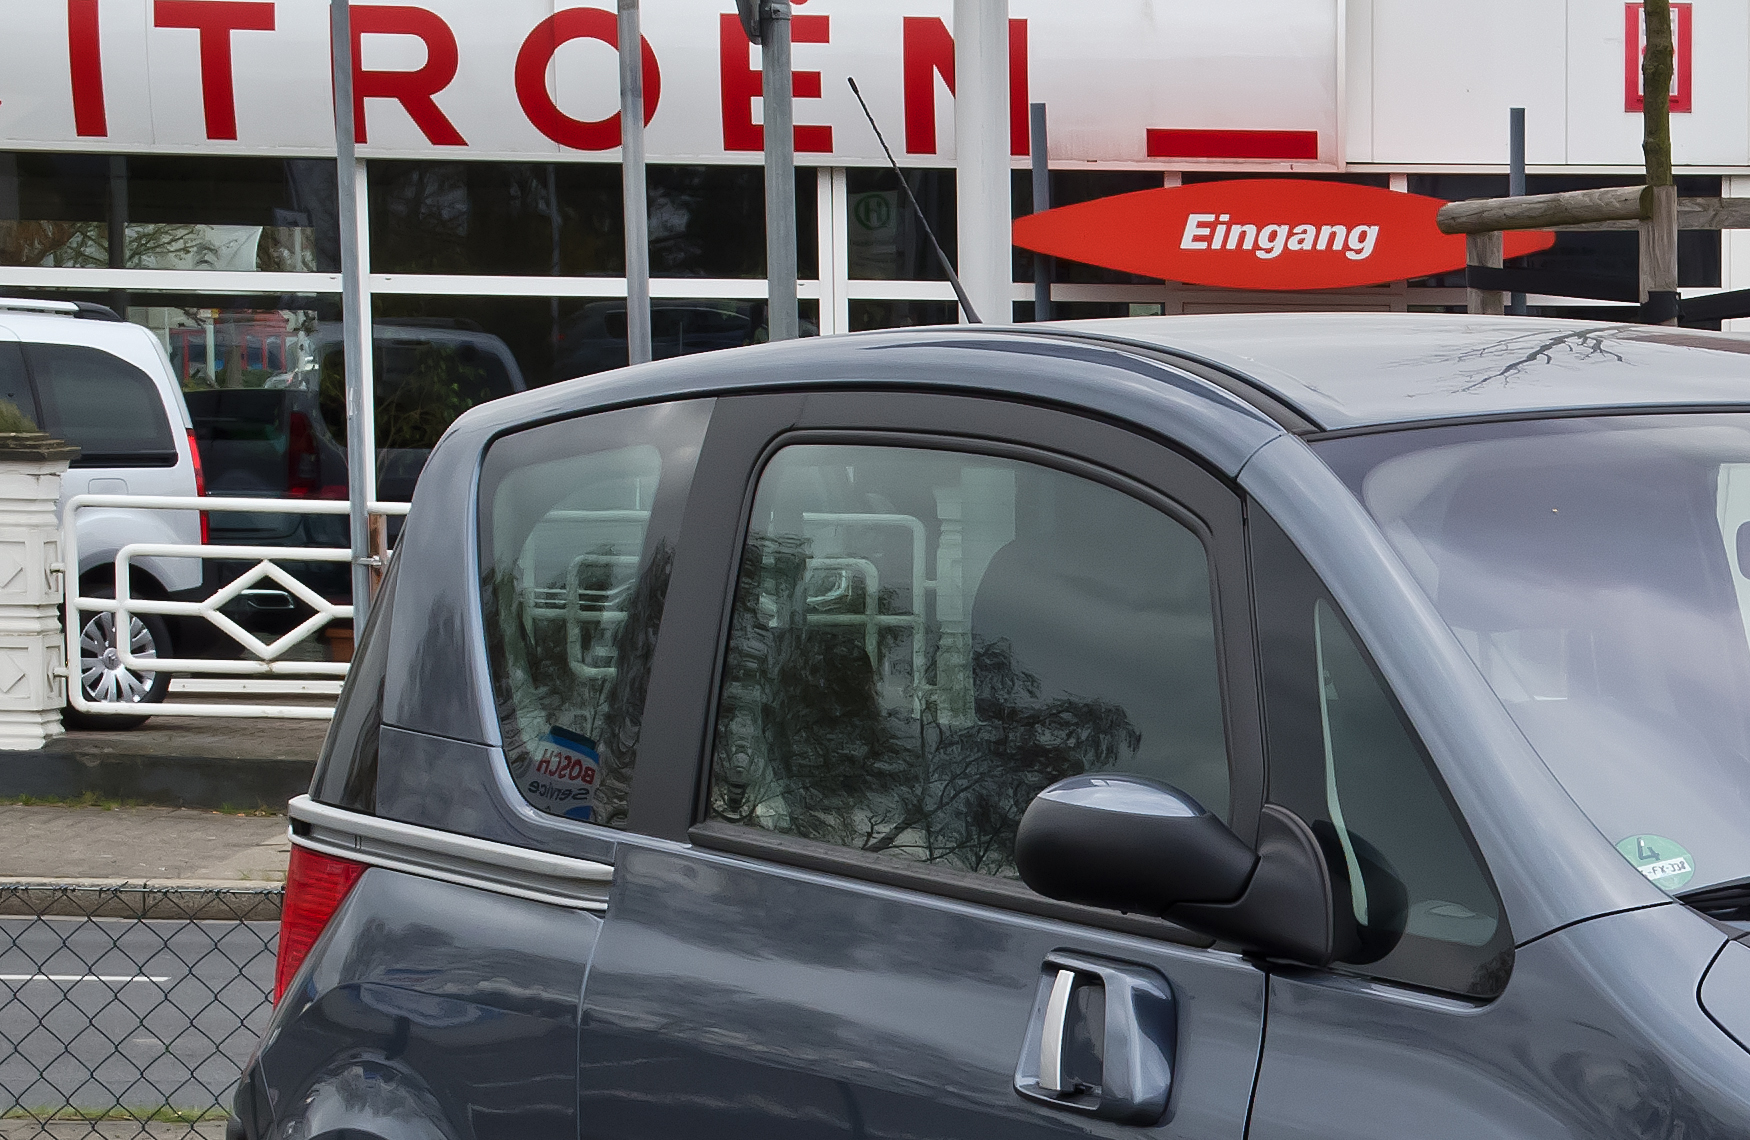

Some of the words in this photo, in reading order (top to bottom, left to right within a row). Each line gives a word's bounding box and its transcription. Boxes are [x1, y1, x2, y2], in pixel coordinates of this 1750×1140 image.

[60, 0, 1030, 156] ITROËN
[1180, 213, 1380, 260] Eingang
[1637, 837, 1661, 861] 4
